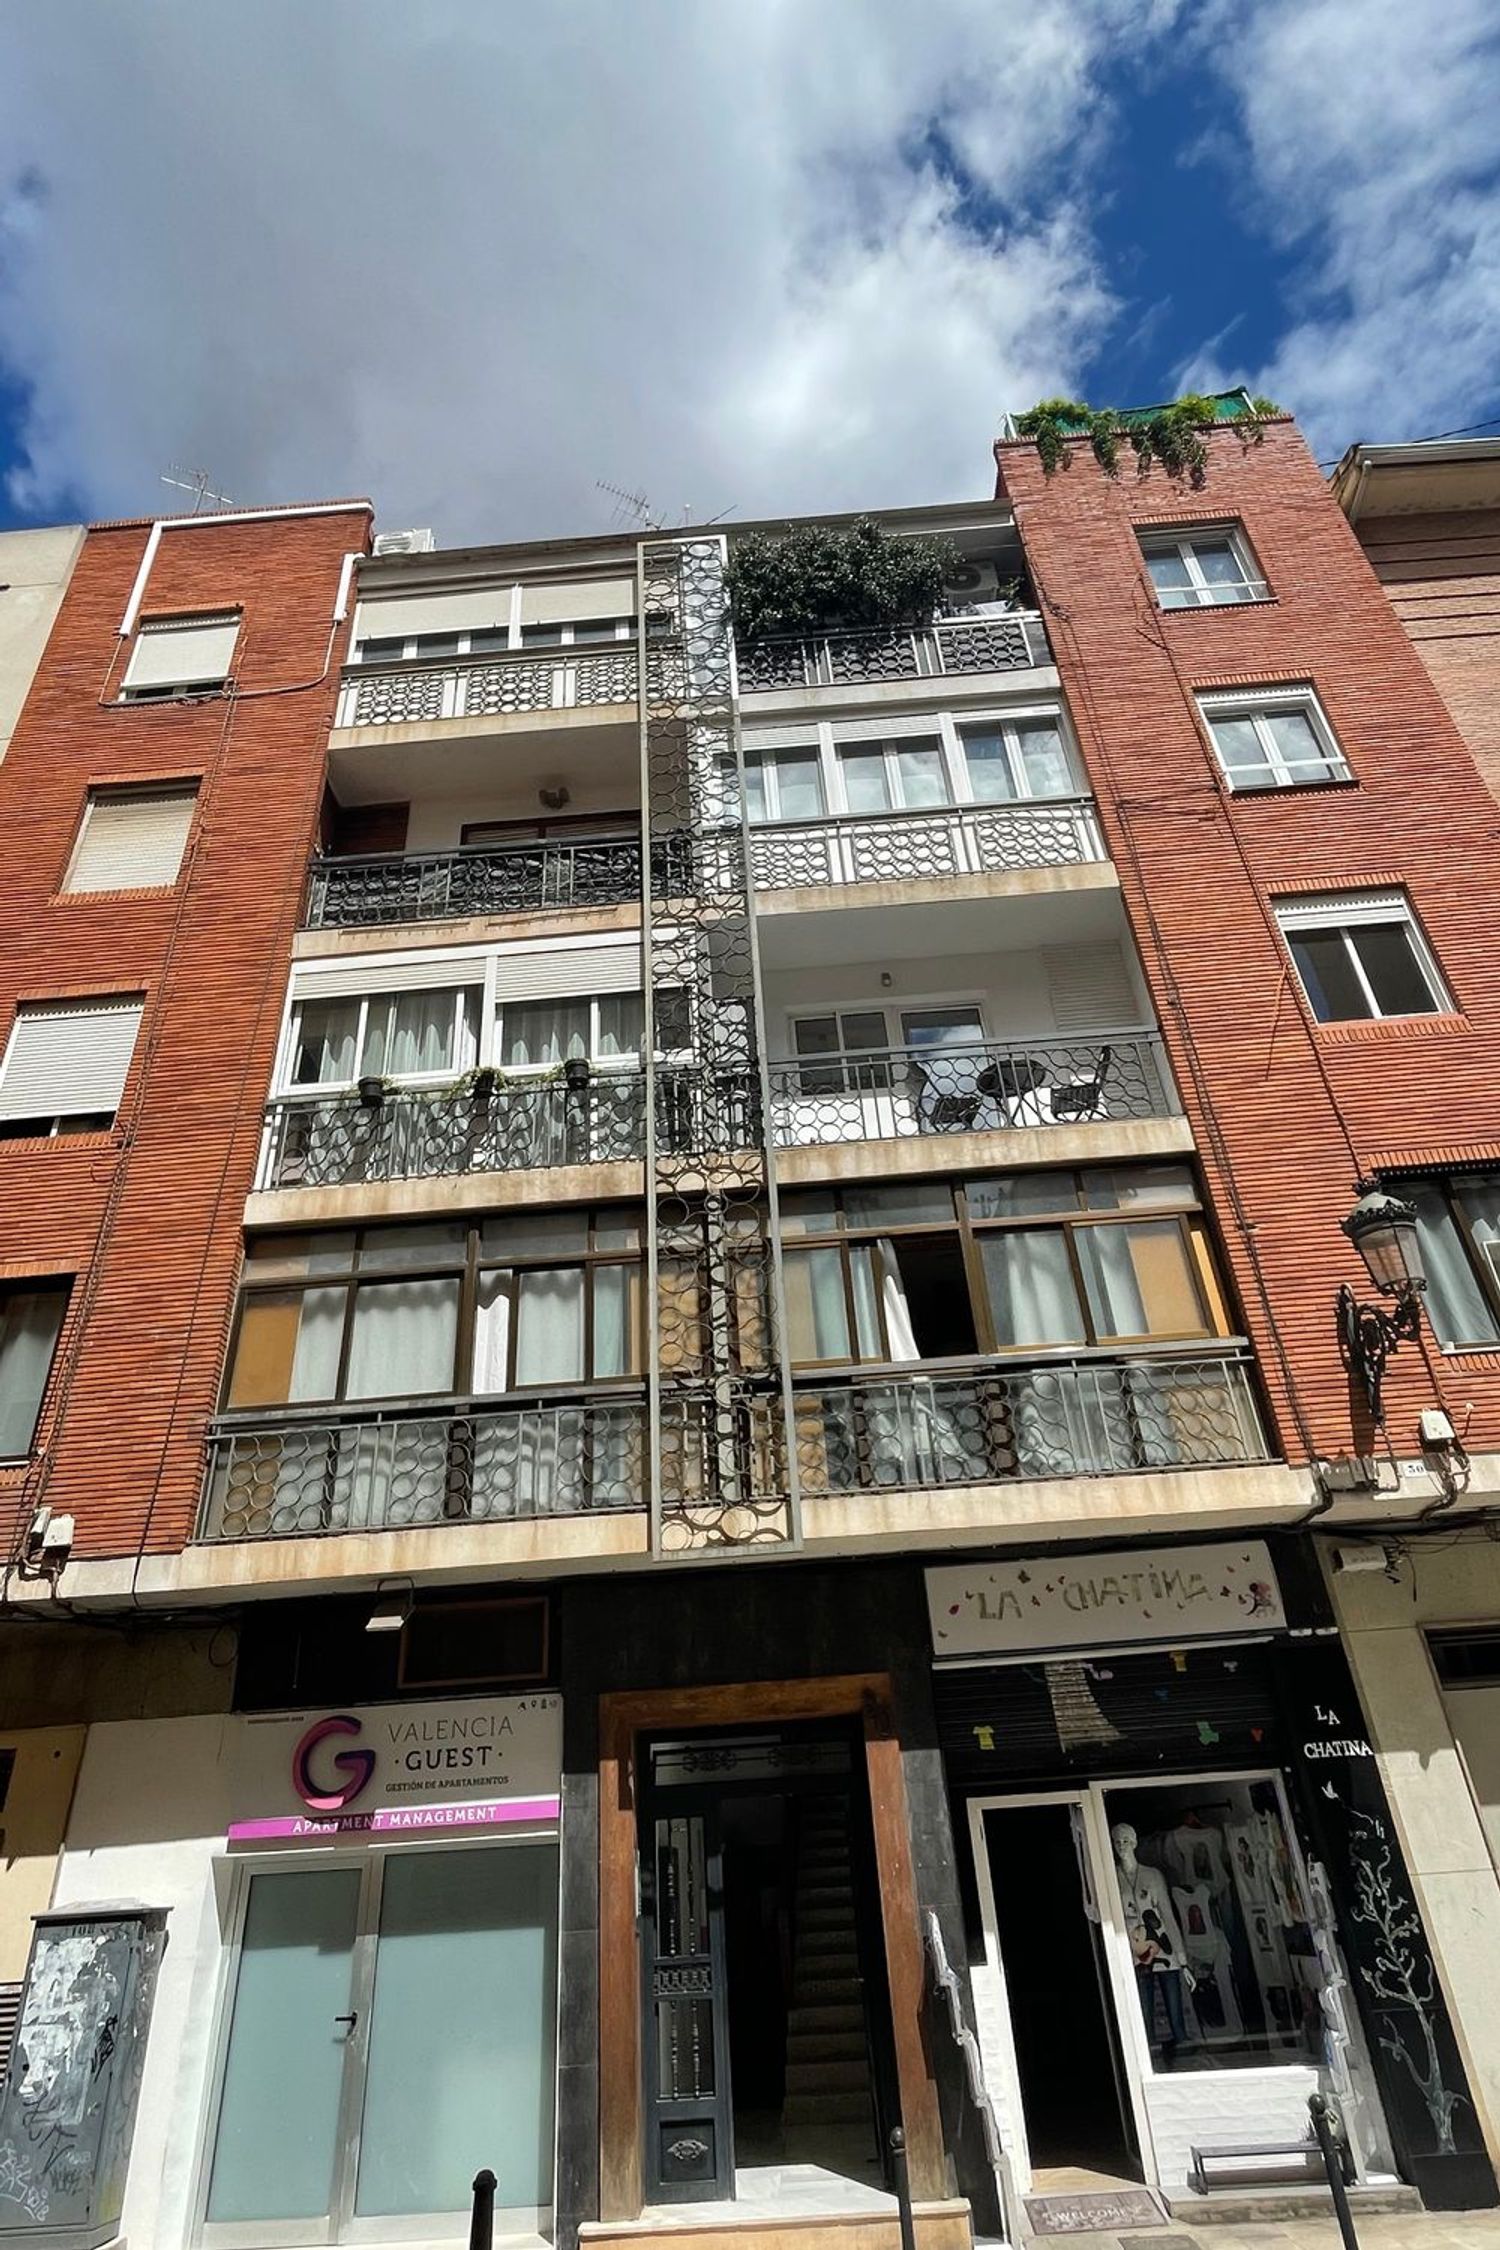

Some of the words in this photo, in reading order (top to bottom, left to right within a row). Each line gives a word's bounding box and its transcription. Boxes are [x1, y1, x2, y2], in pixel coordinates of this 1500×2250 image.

[976, 1591, 1024, 1621] LA
[1314, 1706, 1340, 1726] LA
[387, 1715, 514, 1743] VALENCIA
[1303, 1740, 1373, 1759] CHATINA
[424, 1780, 437, 1790] DE
[437, 1775, 510, 1789] APARTAMENTOS
[292, 1814, 384, 1833] APARTMENT
[389, 1807, 497, 1826] MANAGEMENT
